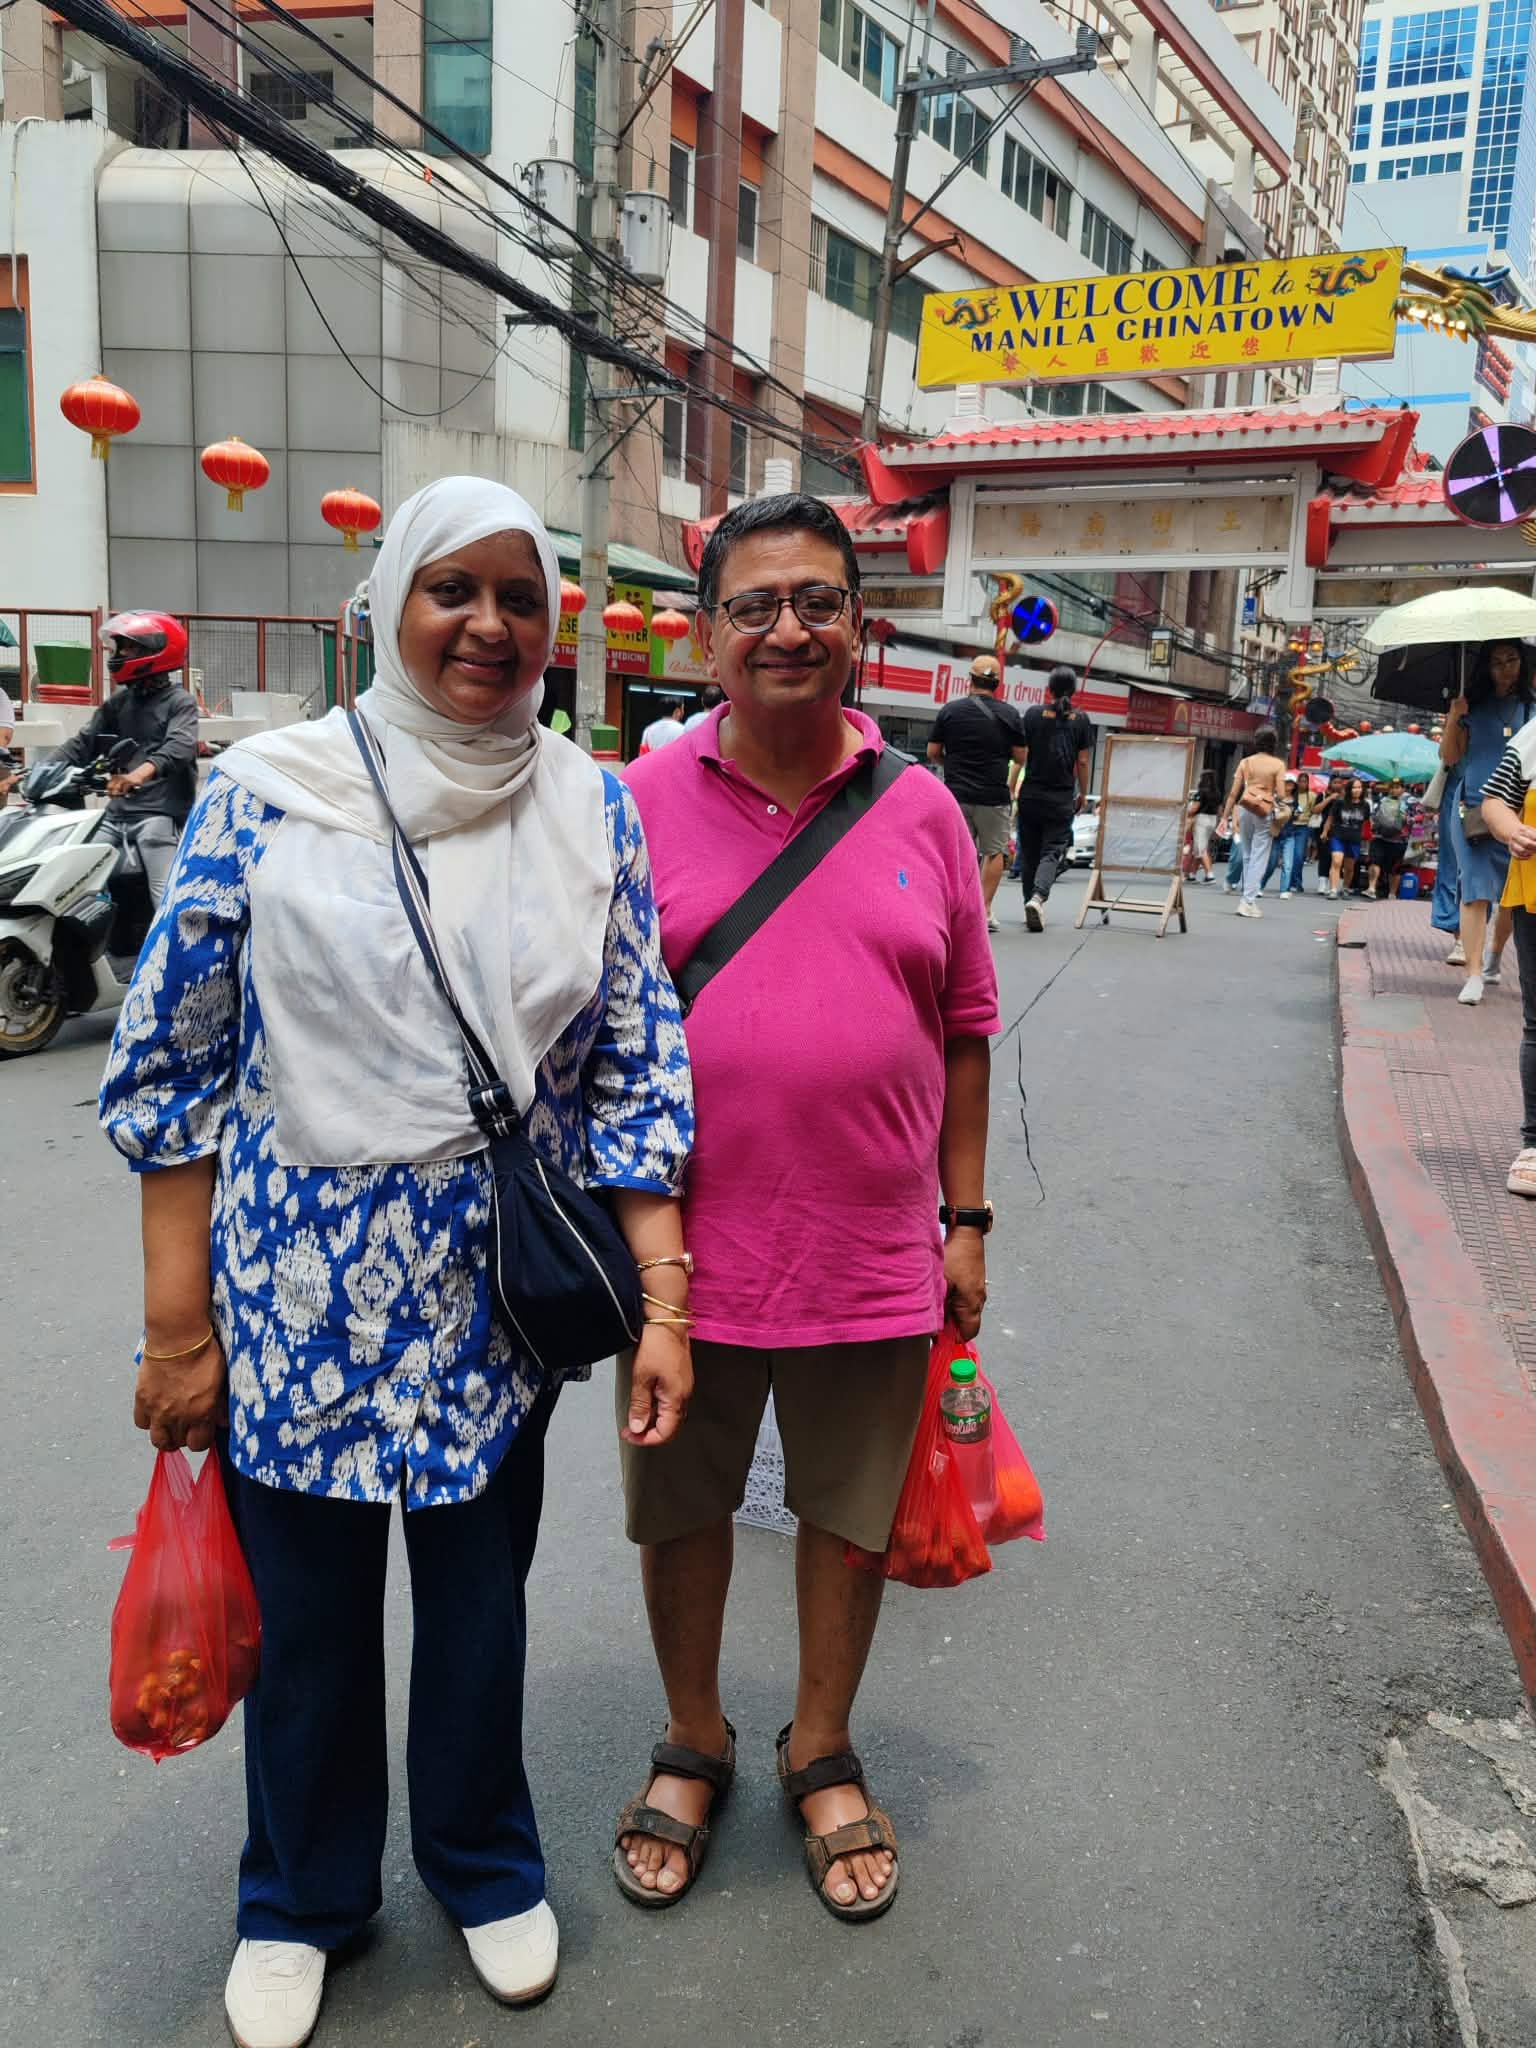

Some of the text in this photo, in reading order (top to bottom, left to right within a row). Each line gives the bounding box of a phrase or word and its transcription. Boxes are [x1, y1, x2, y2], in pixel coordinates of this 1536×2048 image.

[1008, 267, 1295, 323] WELCOME to
[971, 301, 1334, 352] MANILA CHINATOWN
[1014, 680, 1042, 704] drug
